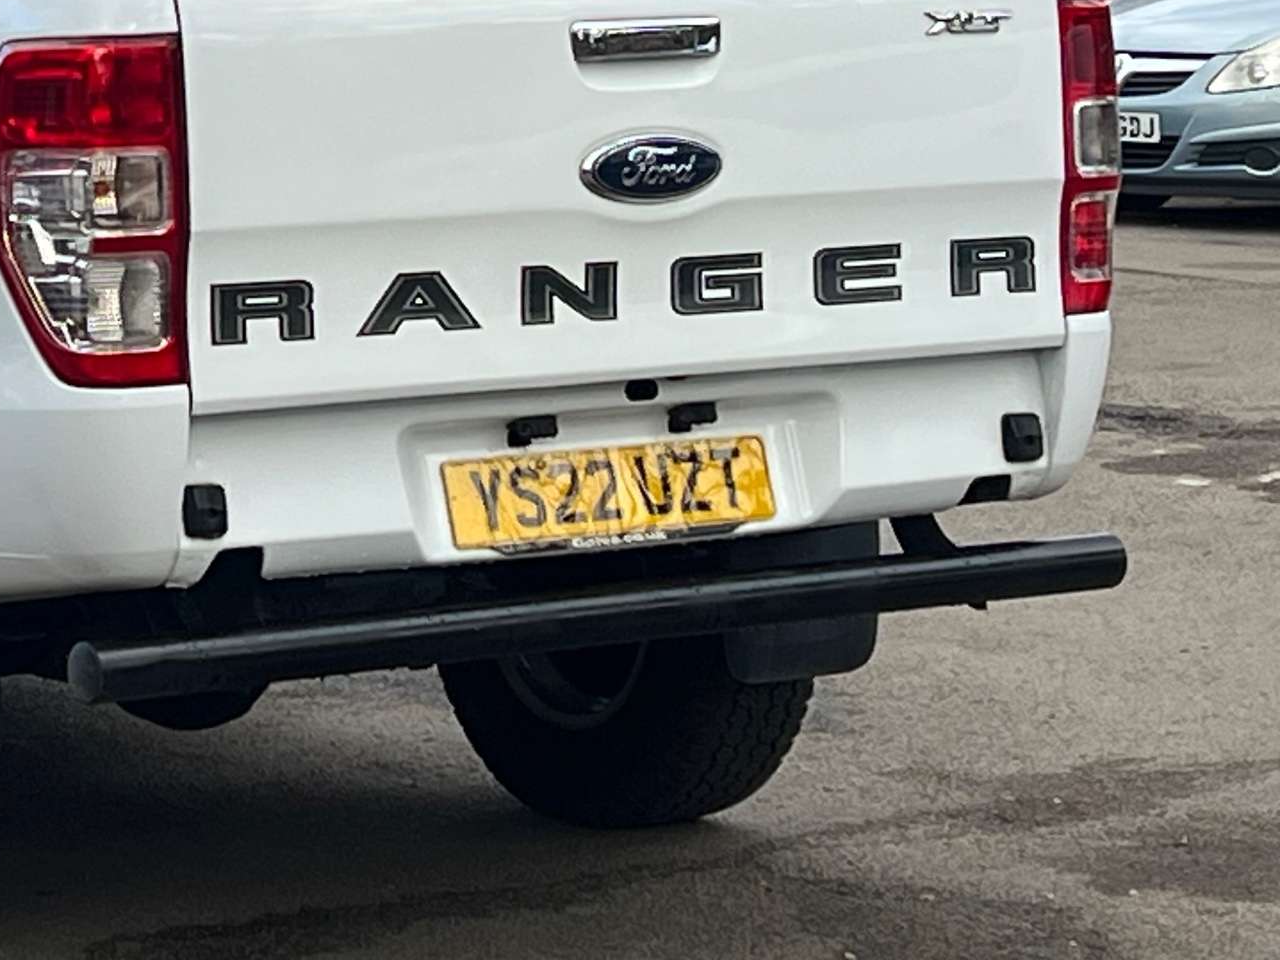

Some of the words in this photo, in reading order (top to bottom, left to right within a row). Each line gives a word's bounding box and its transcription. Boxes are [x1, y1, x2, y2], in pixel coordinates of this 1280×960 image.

[1119, 115, 1154, 138] GDJ
[622, 145, 697, 187] Ford
[210, 235, 1037, 346] RANGER
[470, 459, 622, 531] YS22
[633, 447, 740, 515] UZT
